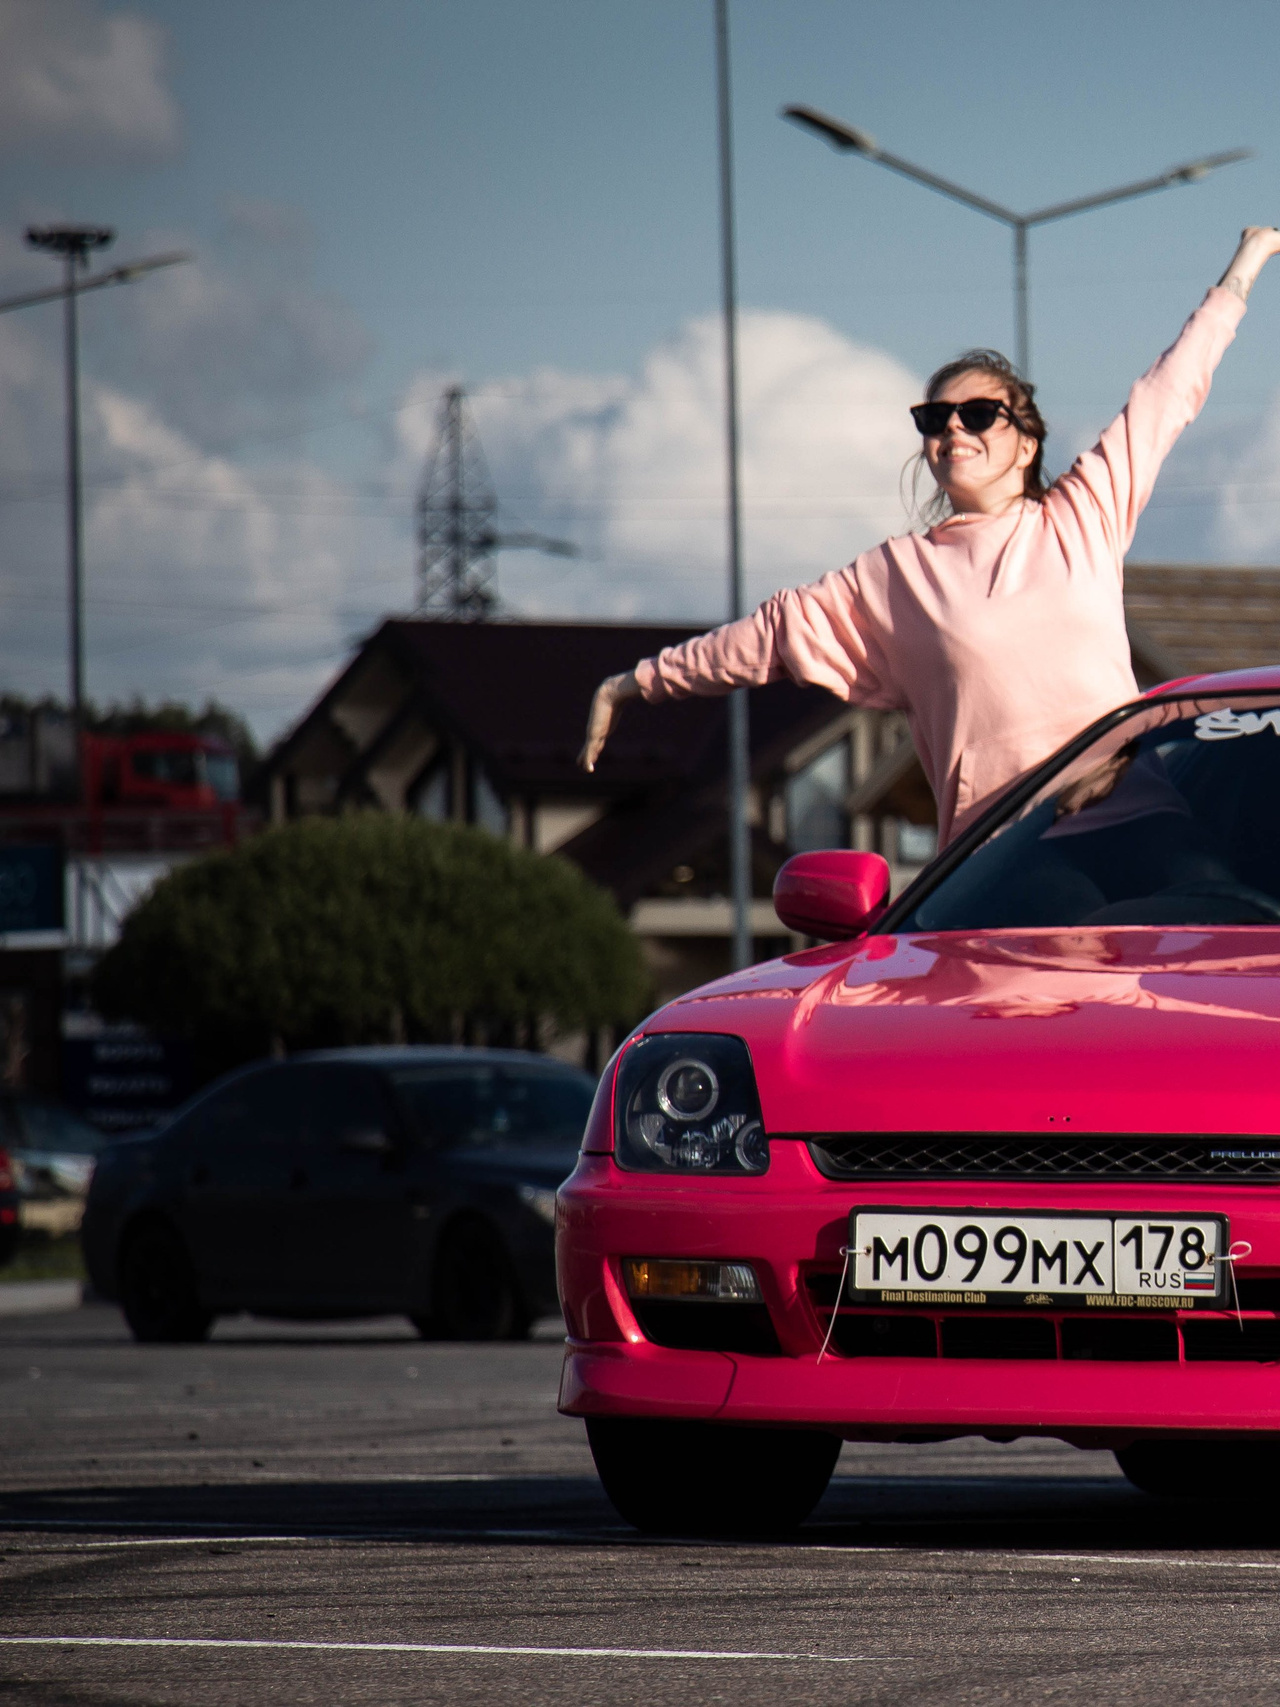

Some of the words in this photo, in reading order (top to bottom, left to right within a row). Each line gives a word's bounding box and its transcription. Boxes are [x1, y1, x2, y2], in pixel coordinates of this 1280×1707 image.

[1119, 1225, 1206, 1271] 178
[1139, 1272, 1181, 1289] RUS
[881, 1290, 905, 1302] Final
[906, 1291, 962, 1303] Destination
[964, 1292, 986, 1304] Club
[1086, 1294, 1194, 1308] WWW.FDC-MOSCOW.RU
